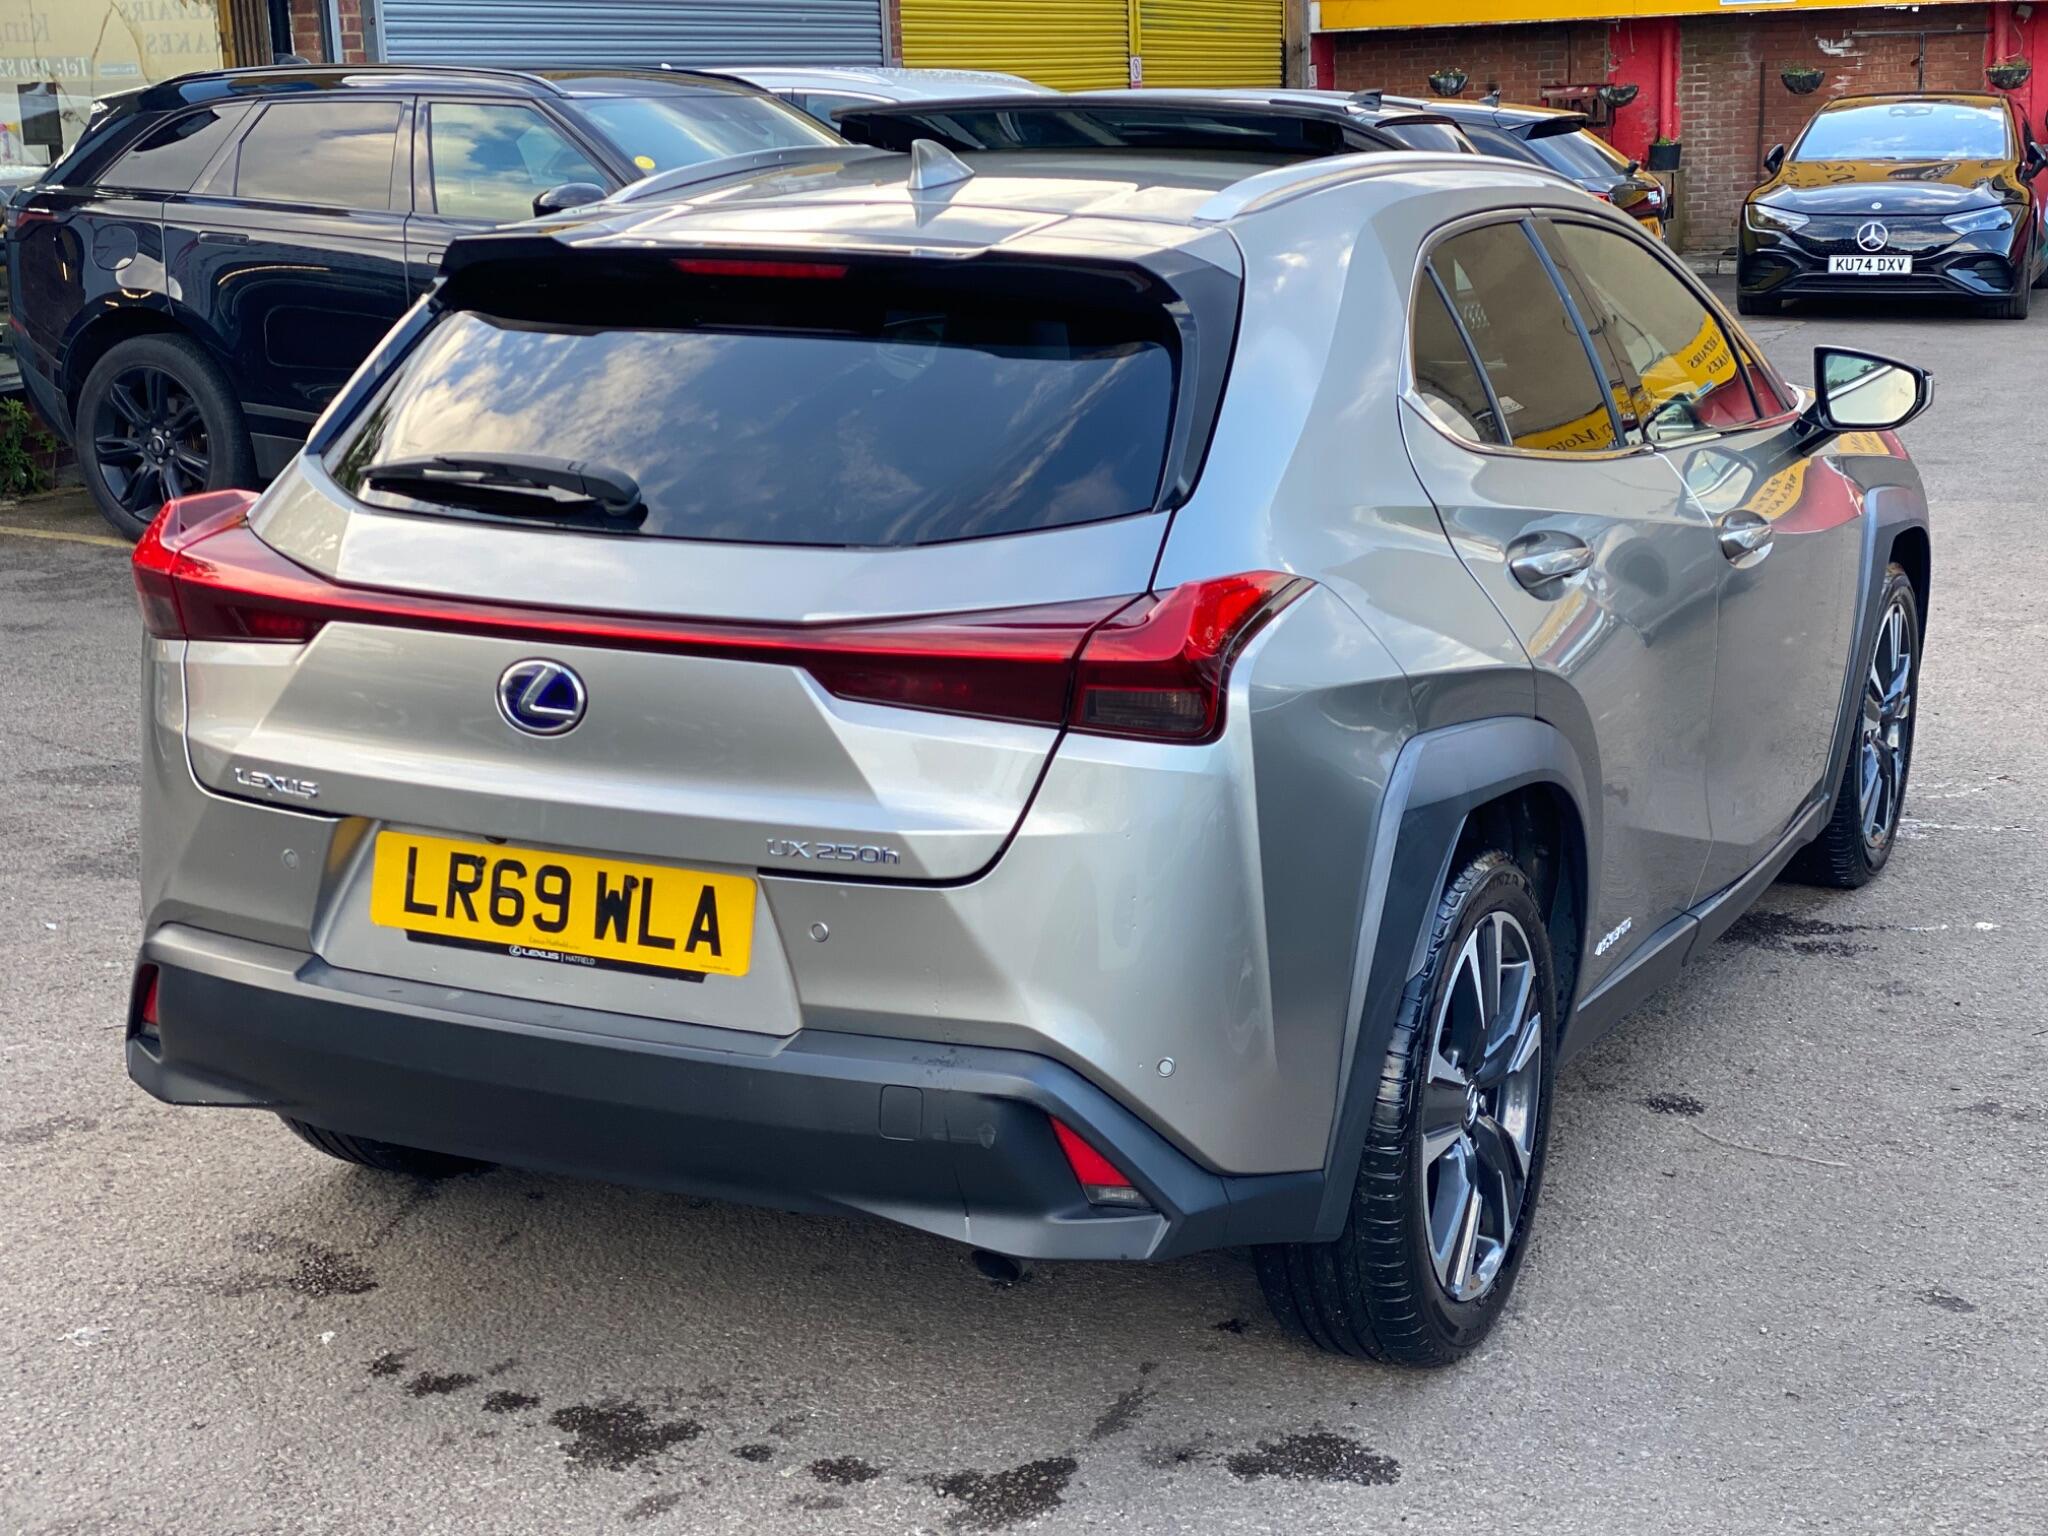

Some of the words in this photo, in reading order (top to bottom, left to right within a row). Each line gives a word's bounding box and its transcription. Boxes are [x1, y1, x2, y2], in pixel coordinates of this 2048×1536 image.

[1835, 258, 1873, 272] KU74
[1877, 258, 1906, 272] DXV
[234, 767, 319, 799] LEXUS
[766, 838, 812, 859] UX
[816, 842, 901, 866] 250h
[403, 846, 571, 934] LR69
[594, 870, 723, 957] WLA
[522, 947, 560, 960] LEXUS
